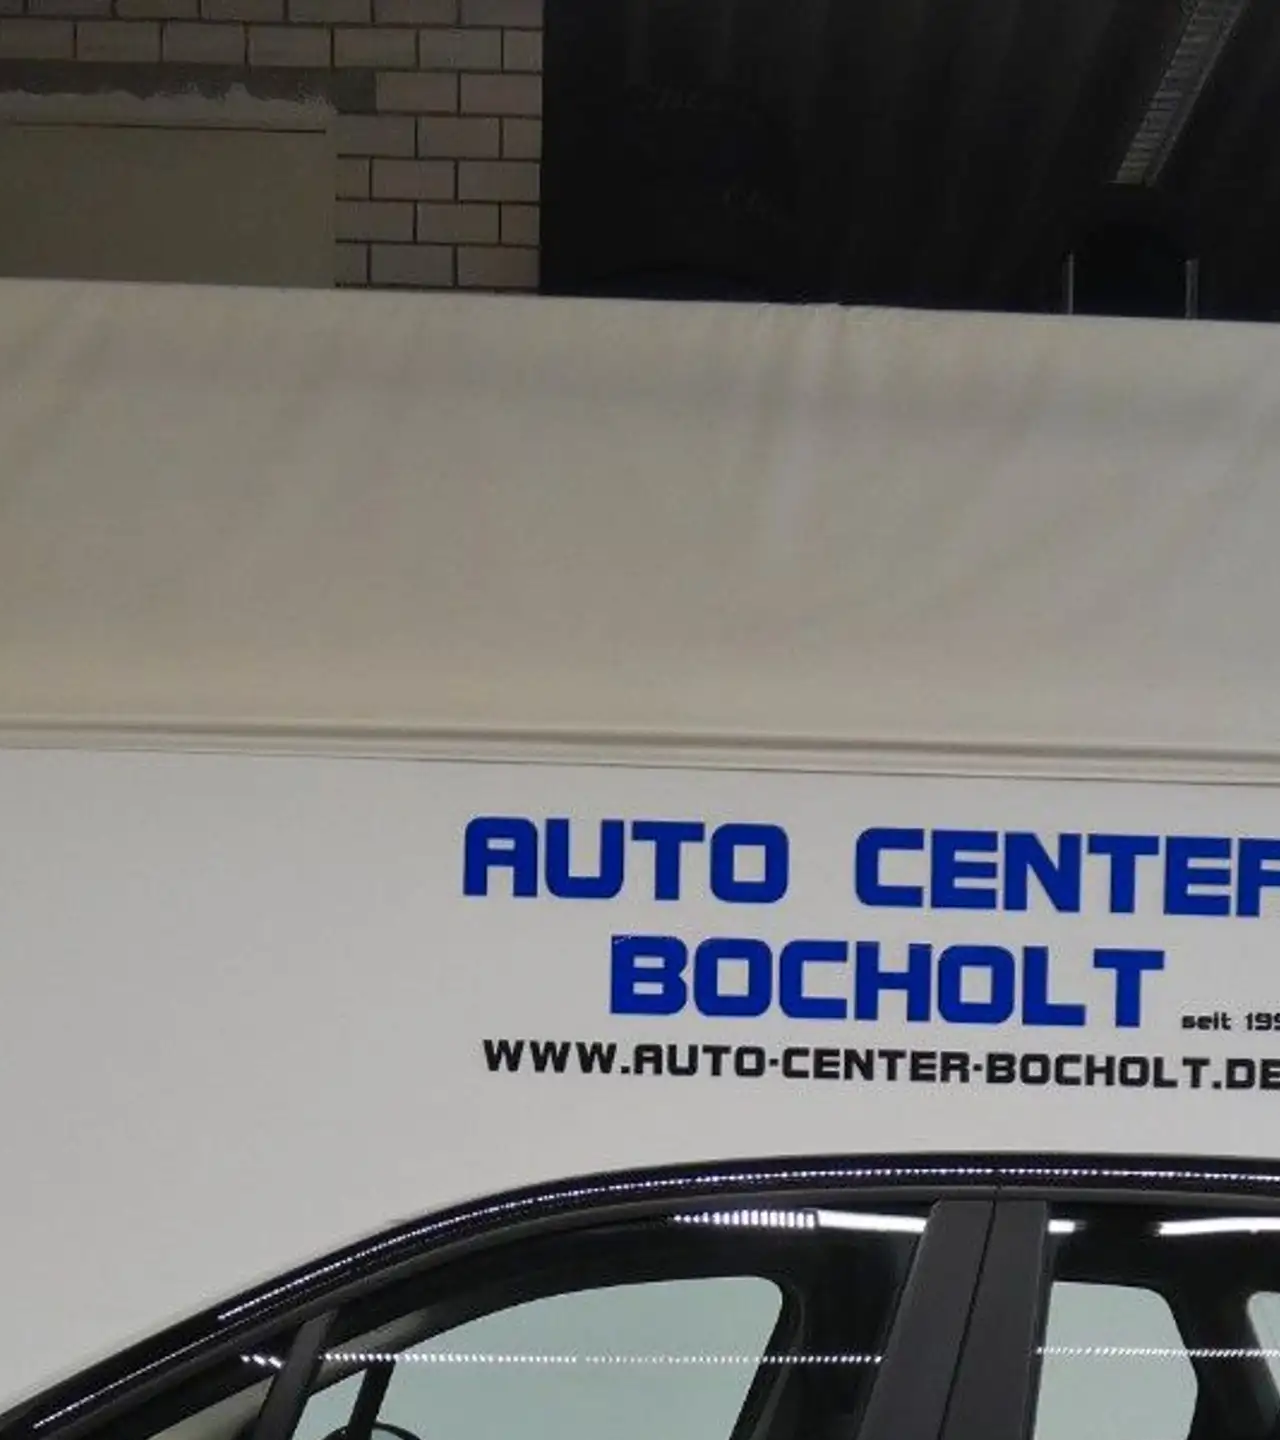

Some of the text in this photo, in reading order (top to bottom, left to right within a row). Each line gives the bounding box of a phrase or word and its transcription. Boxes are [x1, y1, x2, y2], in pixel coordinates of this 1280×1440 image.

[464, 816, 790, 905] AUTO
[610, 935, 1167, 1029] BOCHOLT
[1182, 1011, 1232, 1031] seit
